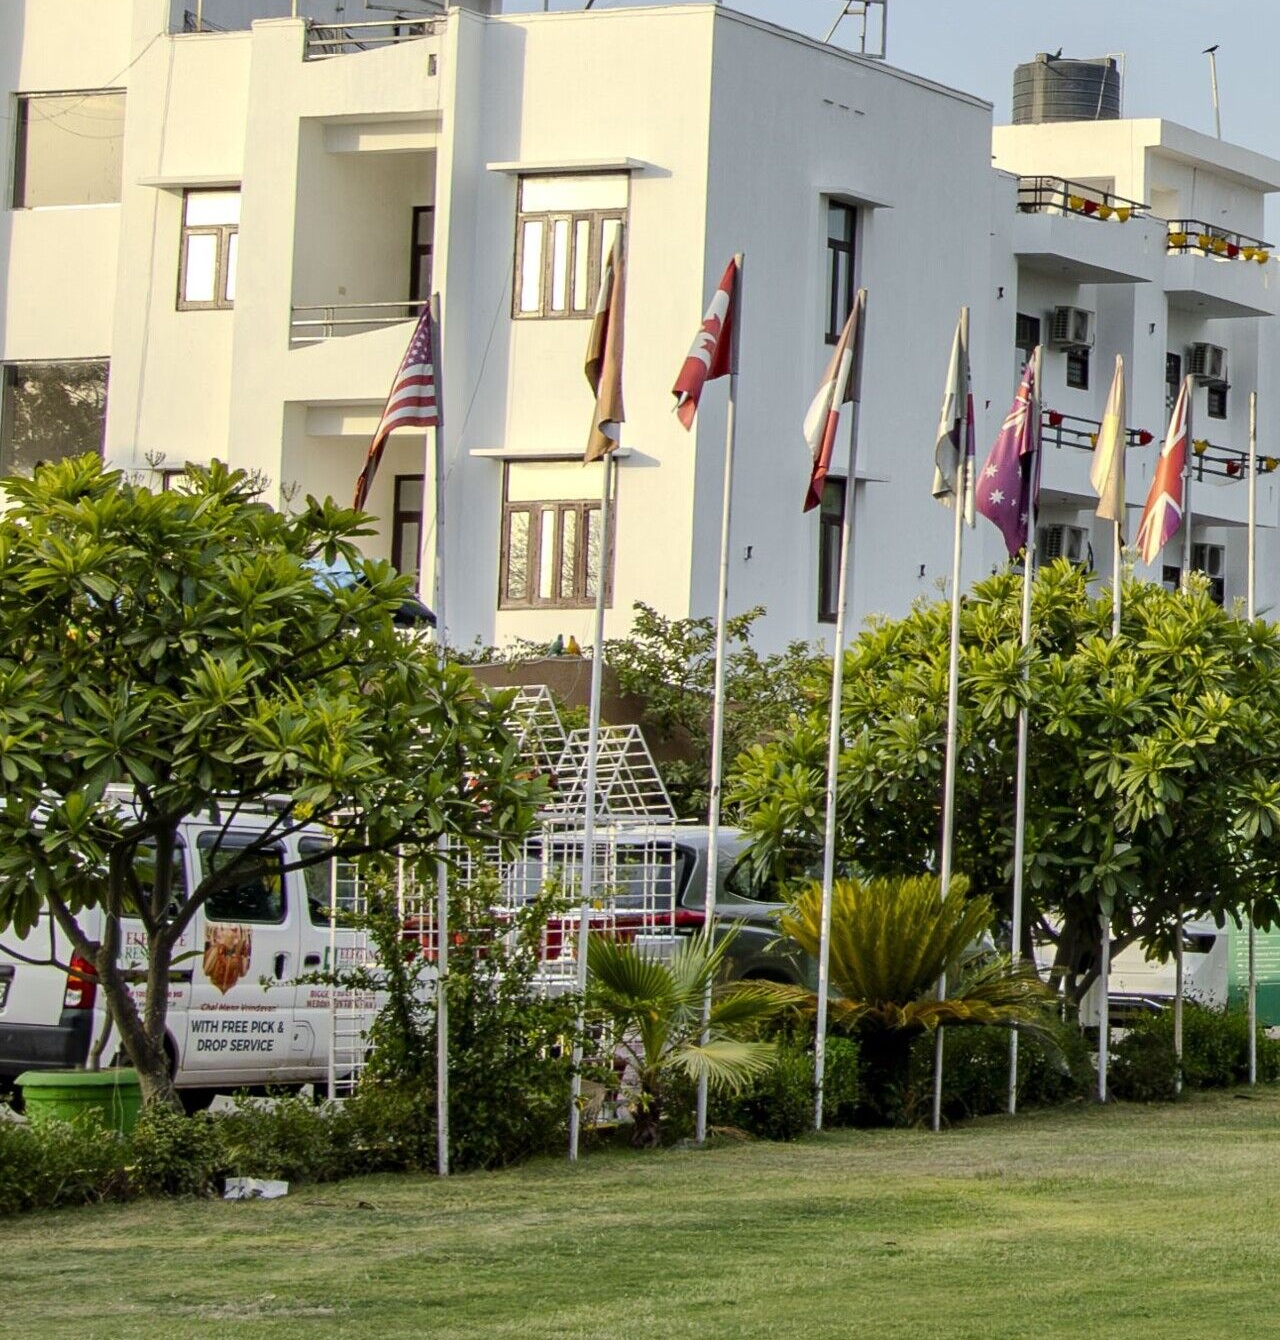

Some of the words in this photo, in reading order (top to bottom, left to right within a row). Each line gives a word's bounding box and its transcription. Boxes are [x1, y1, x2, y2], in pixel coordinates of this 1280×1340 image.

[191, 1020, 219, 1033] WITH
[221, 1020, 249, 1033] FREE
[251, 1020, 276, 1034] PICK
[277, 1021, 285, 1034] &
[197, 1039, 228, 1052] DROP
[229, 1039, 275, 1052] SERVICE
